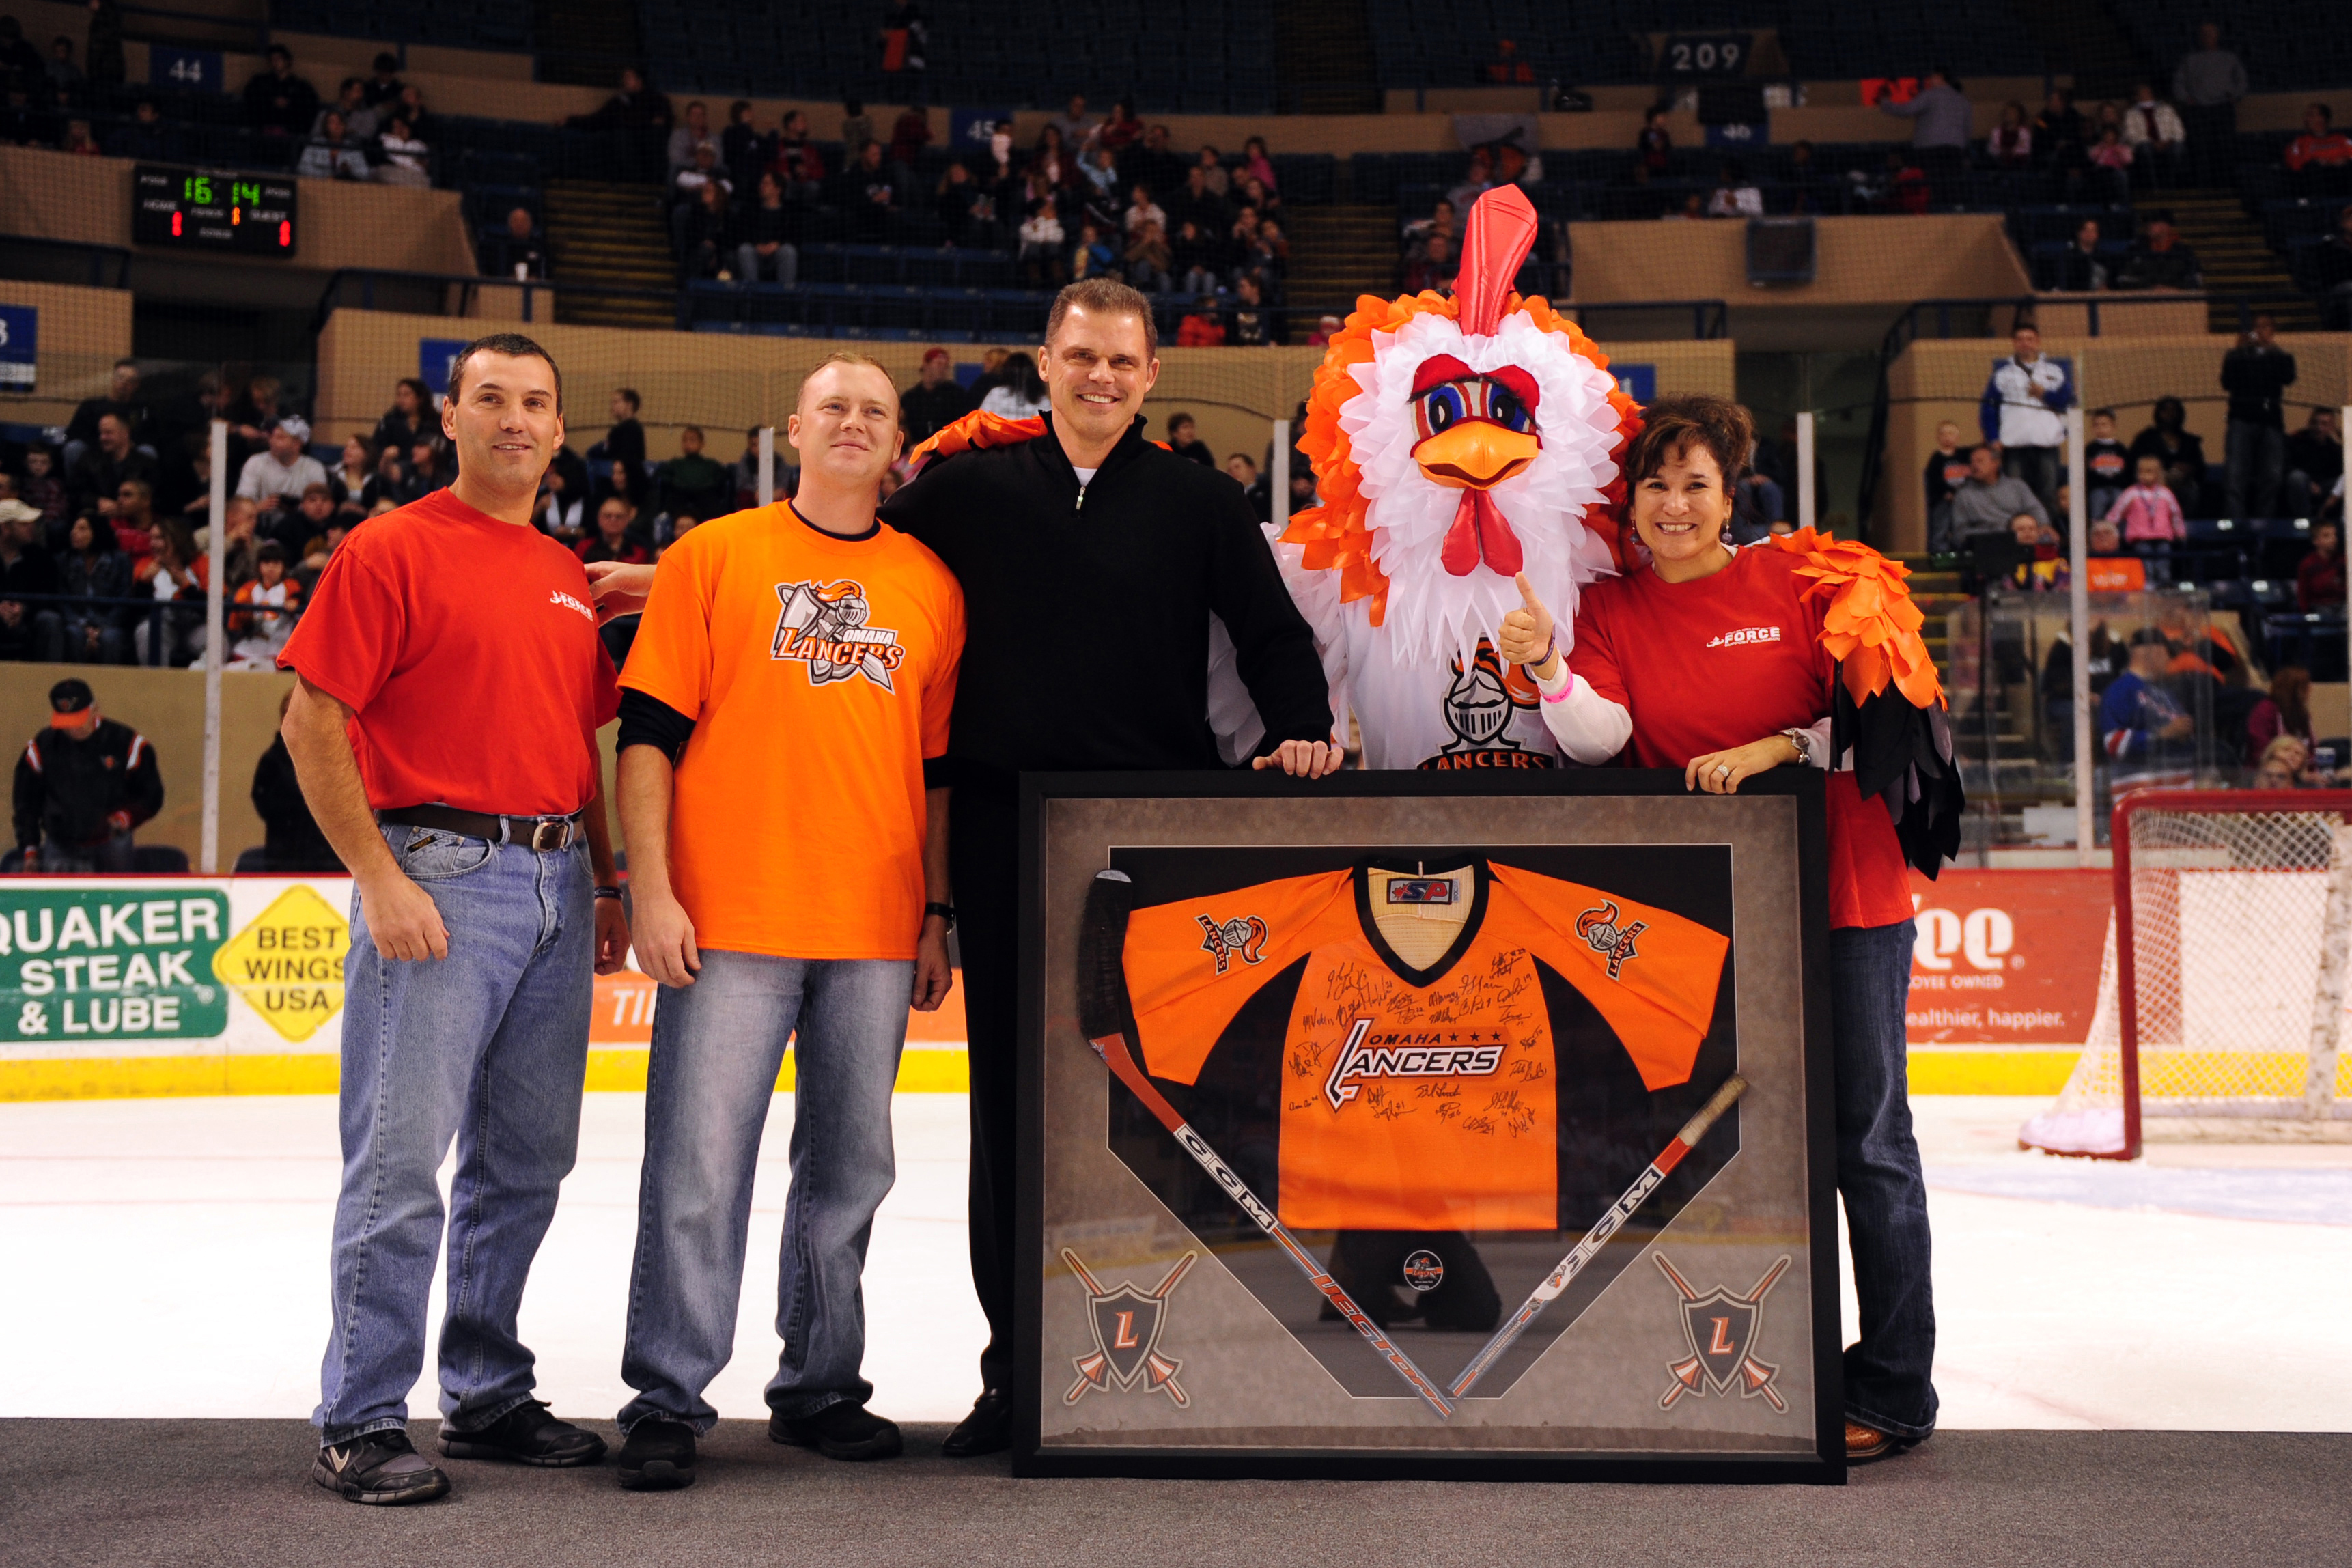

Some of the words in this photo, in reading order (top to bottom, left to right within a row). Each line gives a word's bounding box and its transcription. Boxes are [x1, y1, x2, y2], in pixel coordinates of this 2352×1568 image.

[169, 57, 203, 81] 44
[1672, 42, 1739, 70] 209
[184, 176, 212, 205] 16
[232, 182, 260, 207] 14
[775, 627, 904, 669] LANCERS
[842, 628, 894, 645] OMAHA
[1423, 751, 1545, 769] ANCERS
[1401, 882, 1448, 901] SP
[0, 899, 220, 955] UAKER
[259, 927, 341, 950] BEST
[1201, 919, 1227, 969] LANCERS
[1912, 893, 2013, 970] ee
[1610, 924, 1642, 974] LANCERS
[20, 951, 195, 996] STEAK
[1909, 975, 1946, 989] OYEE
[1951, 975, 2003, 990] OWNED
[18, 1002, 48, 1035] &
[63, 996, 180, 1033] LUBE
[266, 989, 330, 1012] USA
[1988, 1008, 2064, 1030] happier.
[1369, 1033, 1441, 1045] OMAHA
[1325, 1019, 1505, 1110] LANCERS
[1185, 1134, 1273, 1228] CCM
[1115, 1311, 1138, 1349] L
[1310, 1274, 1438, 1400] VECTOR
[1709, 1317, 1735, 1354] L
